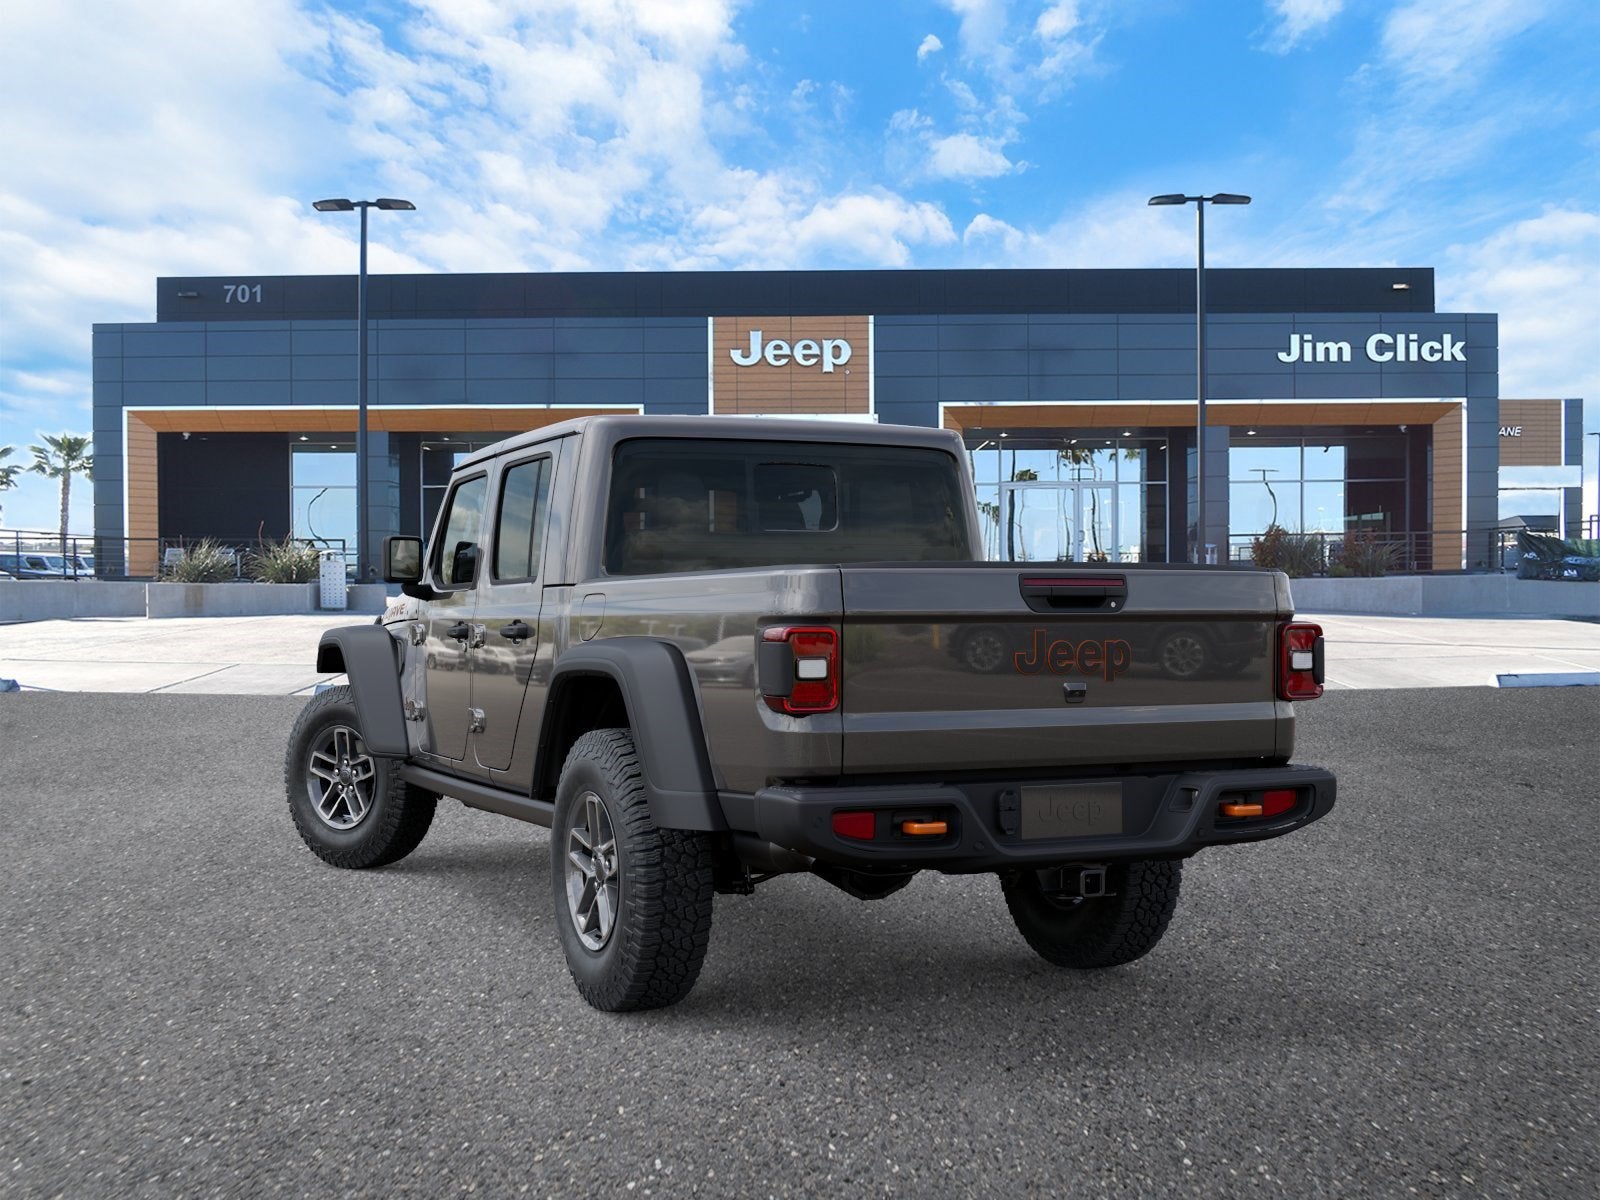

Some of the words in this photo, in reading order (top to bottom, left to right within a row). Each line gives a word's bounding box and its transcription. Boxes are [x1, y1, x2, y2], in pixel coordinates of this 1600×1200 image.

[223, 284, 262, 304] 701
[729, 330, 852, 373] Jeep
[1277, 333, 1352, 363] Jim
[1365, 333, 1467, 363] Click
[1014, 629, 1132, 682] Jeep
[1035, 792, 1104, 825] Jeep
